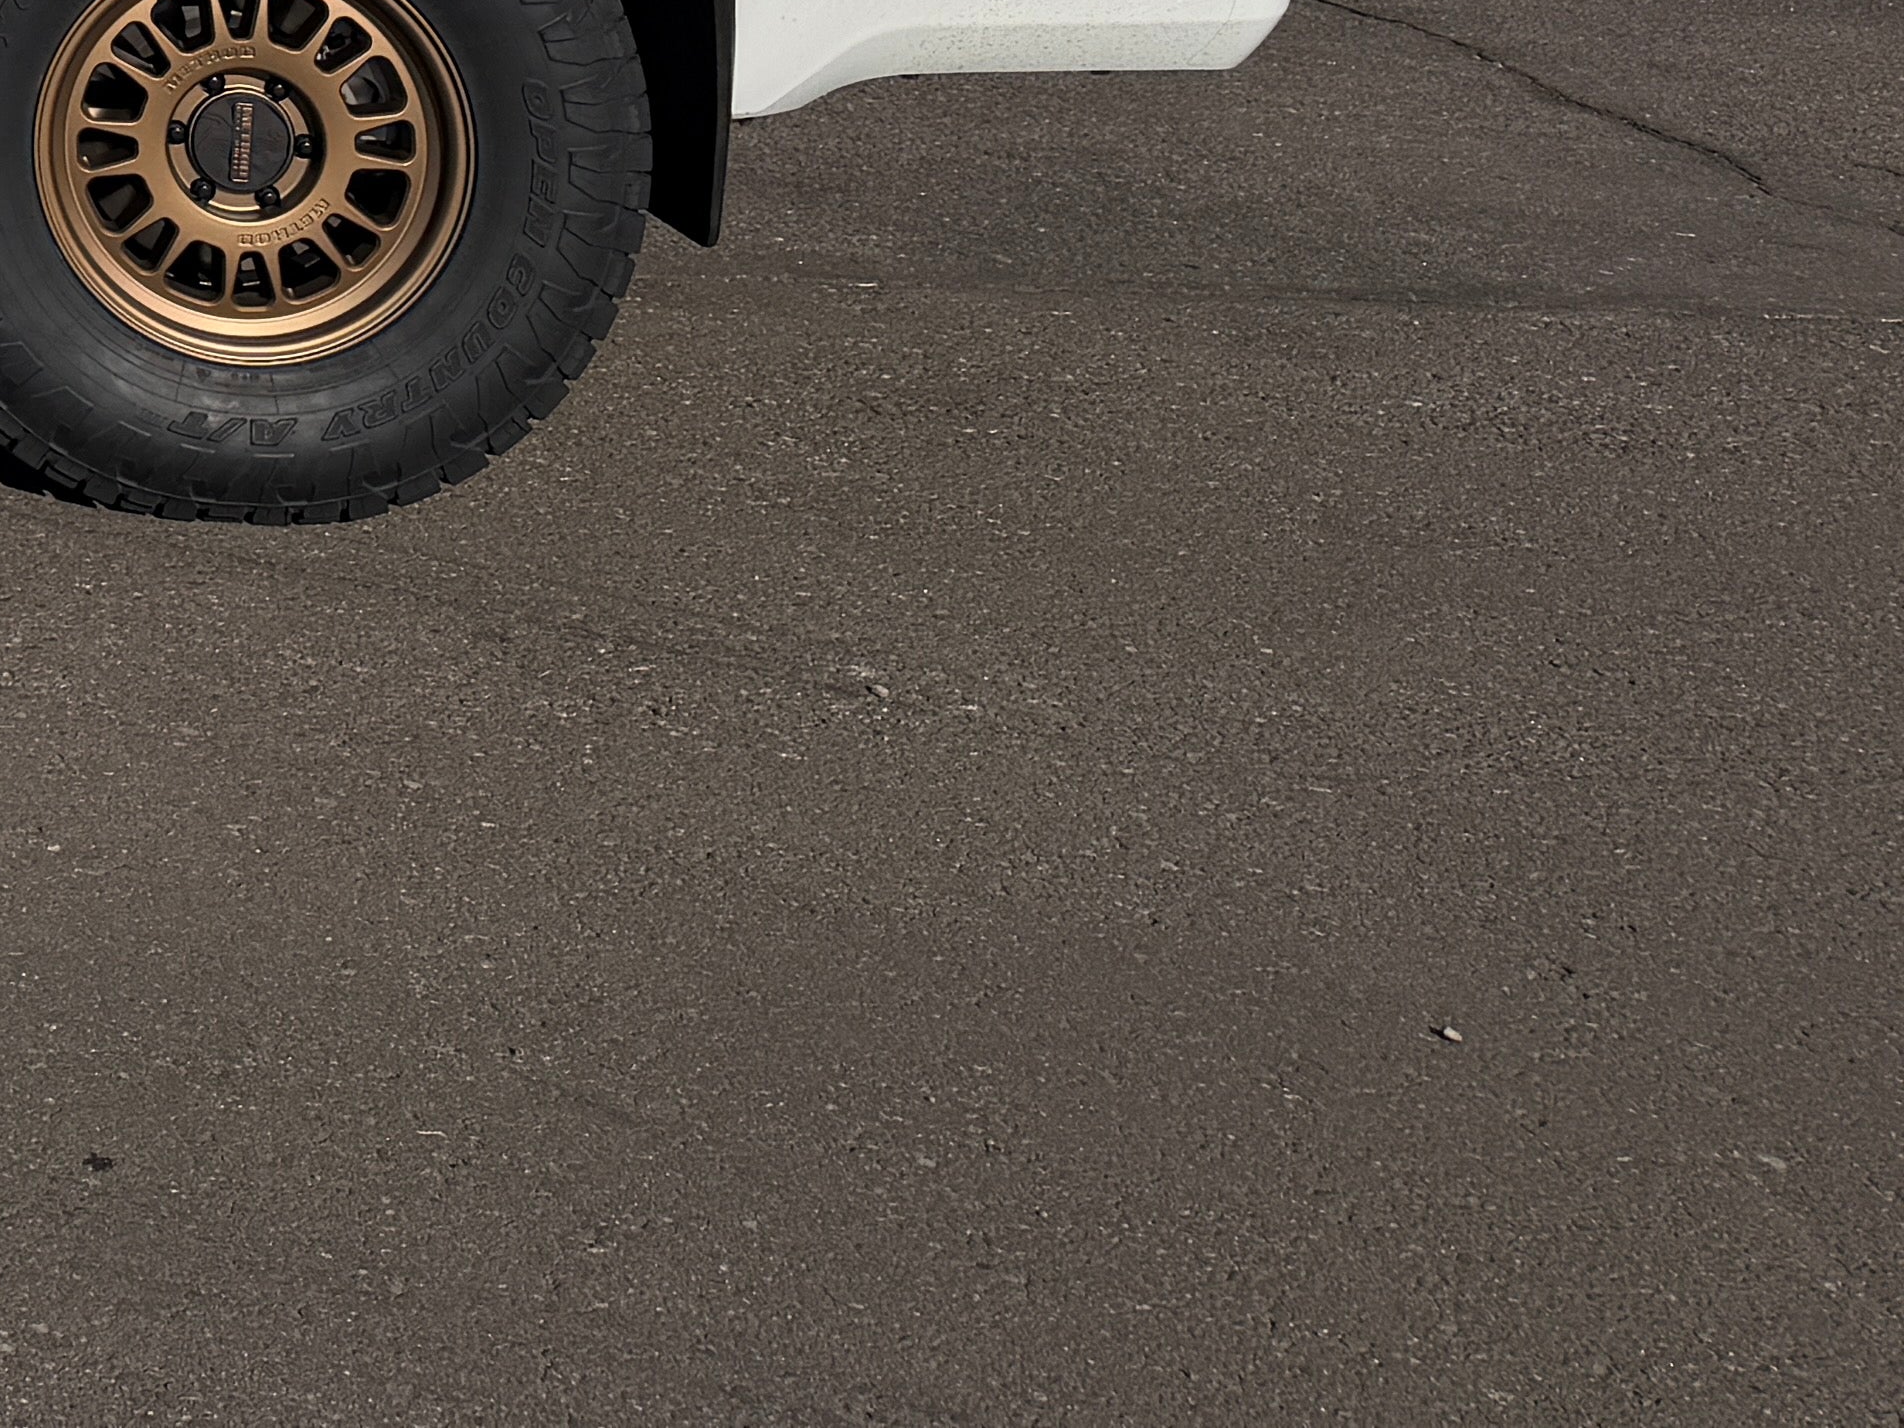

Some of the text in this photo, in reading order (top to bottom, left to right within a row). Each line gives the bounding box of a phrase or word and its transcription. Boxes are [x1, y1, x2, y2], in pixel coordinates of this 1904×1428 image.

[163, 46, 256, 94] METHOD
[237, 197, 331, 247] METHOD
[167, 79, 560, 445] OPEN COUNTRY A/T
